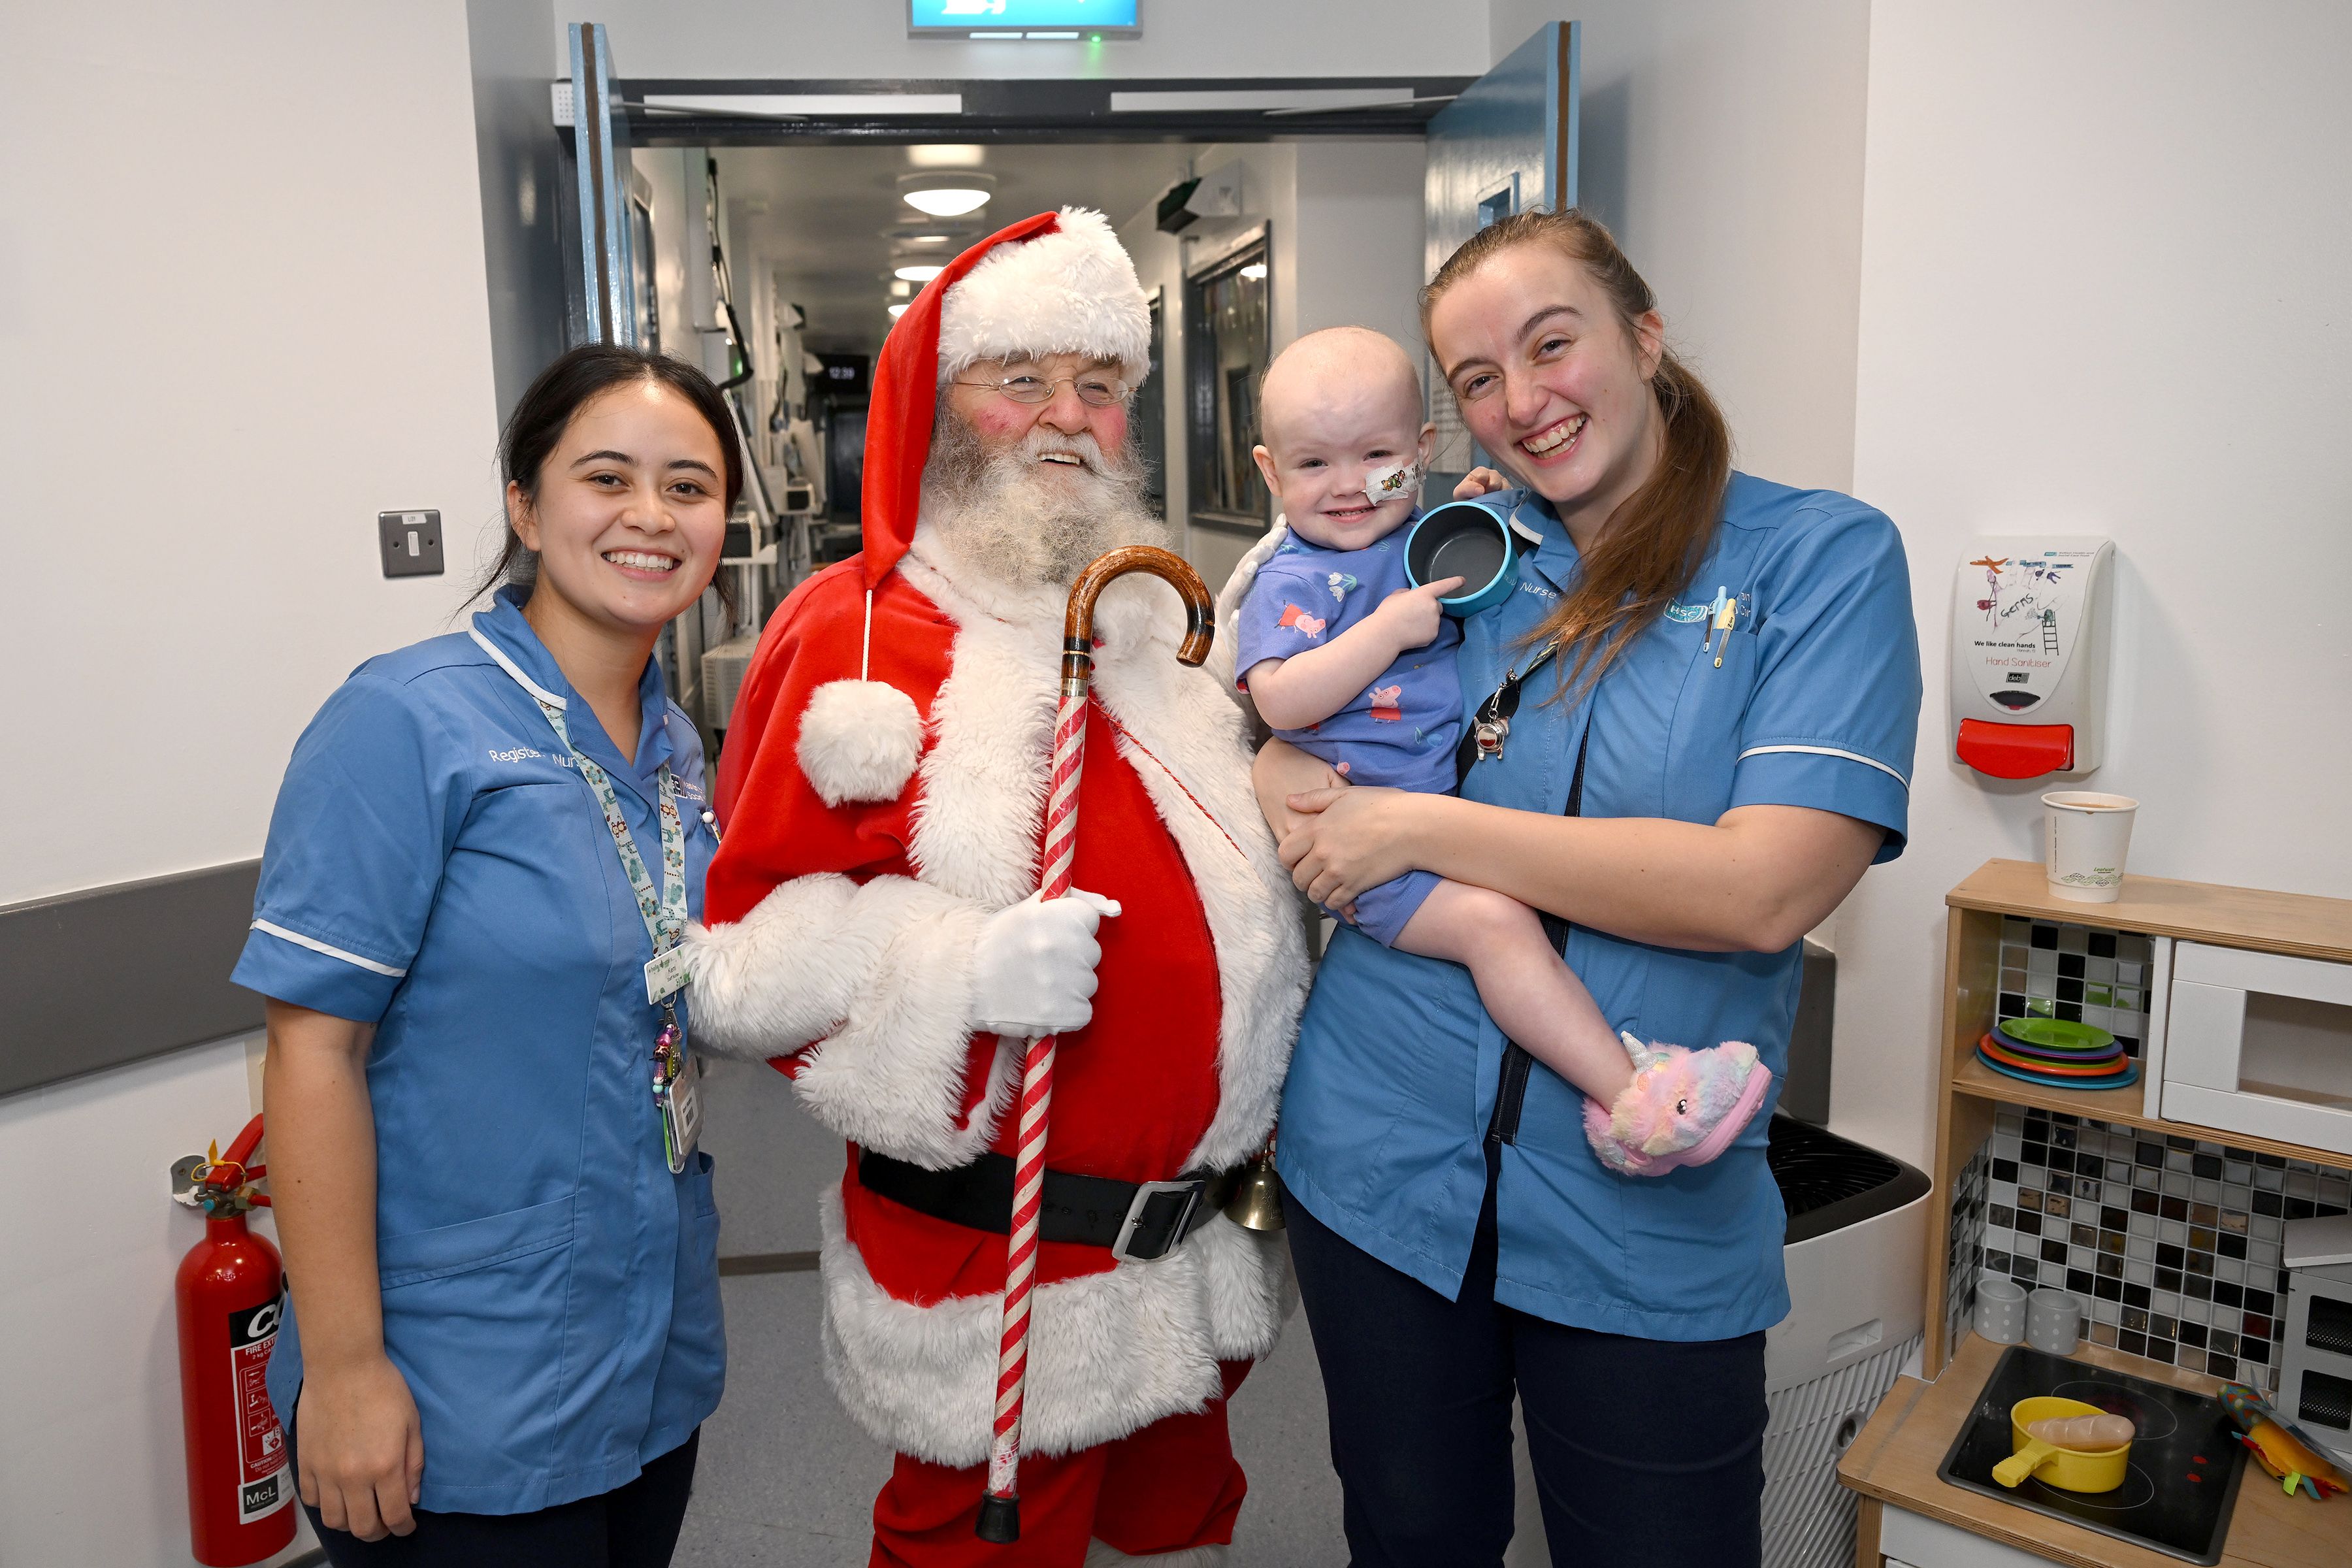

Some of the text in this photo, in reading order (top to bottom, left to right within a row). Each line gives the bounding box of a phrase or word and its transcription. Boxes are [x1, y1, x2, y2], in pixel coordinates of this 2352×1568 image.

[1520, 582, 1557, 599] Nurse
[1671, 605, 1698, 617] HSC
[1986, 657, 2051, 667] Hand Sanitiser
[245, 1335, 277, 1356] FIRE EXT
[246, 1486, 276, 1506] McL
